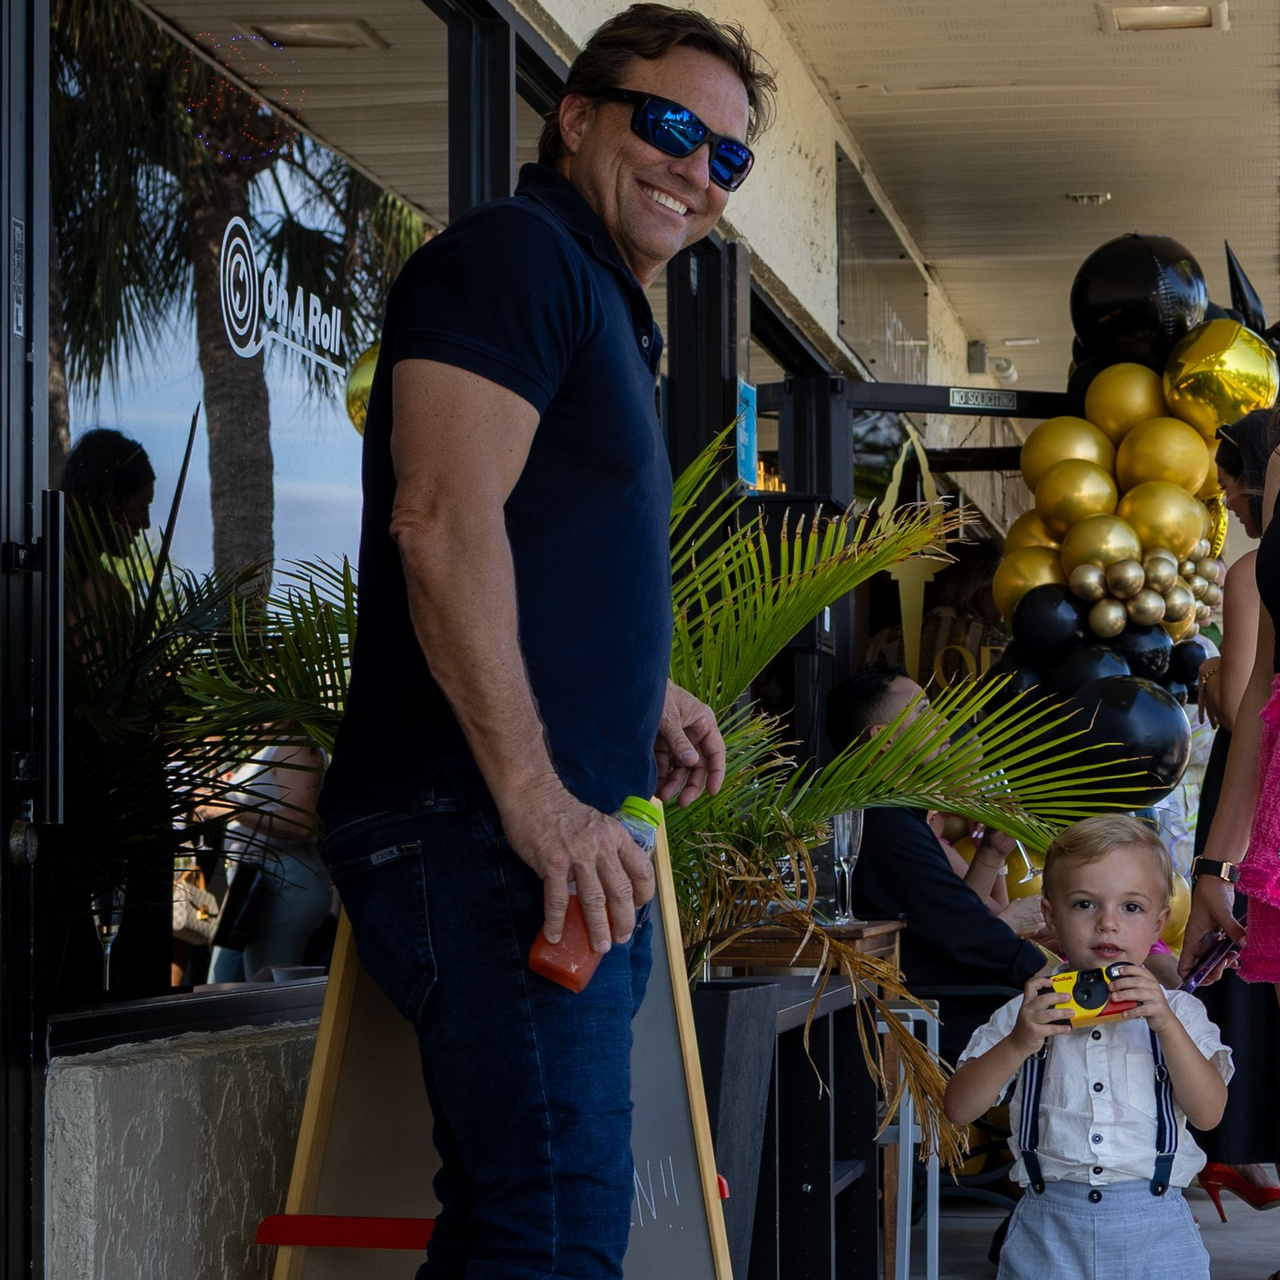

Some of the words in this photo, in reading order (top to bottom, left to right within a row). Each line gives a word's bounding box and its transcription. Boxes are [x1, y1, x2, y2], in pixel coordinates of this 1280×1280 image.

[262, 267, 289, 327] On
[291, 285, 305, 338] A
[308, 292, 342, 356] Roll
[953, 391, 965, 404] NO
[968, 391, 1013, 407] SOLICITING
[1052, 975, 1073, 983] Kodak
[631, 1156, 684, 1231] N!!
